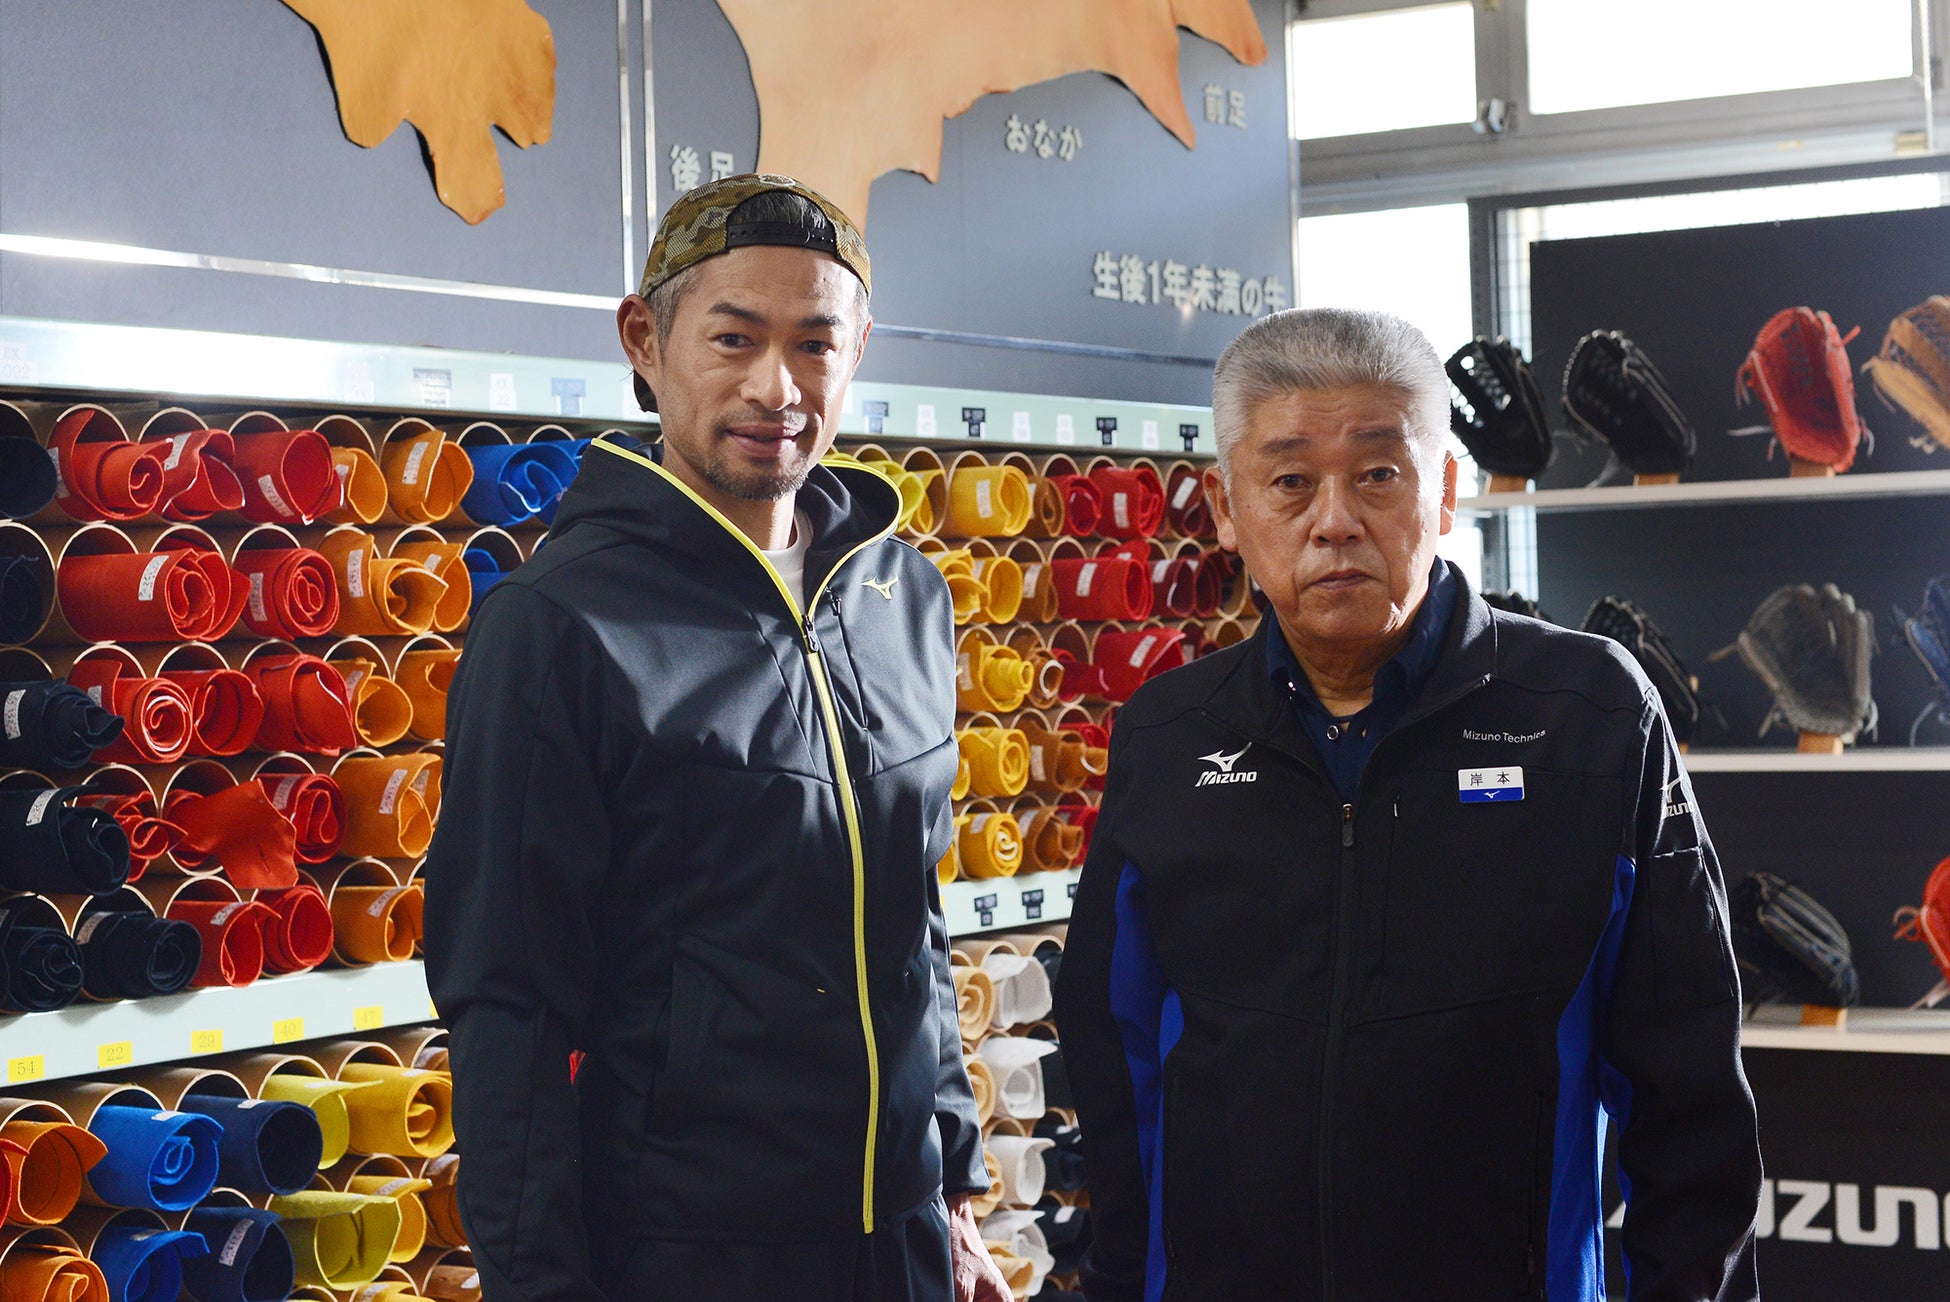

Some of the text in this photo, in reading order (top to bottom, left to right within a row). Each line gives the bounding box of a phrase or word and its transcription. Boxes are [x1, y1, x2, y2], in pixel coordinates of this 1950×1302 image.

[1203, 83, 1247, 129] 前足
[1005, 113, 1083, 161] おなか
[1463, 729, 1501, 741] Mizuno
[1194, 770, 1258, 788] MIZUNO
[1470, 771, 1510, 787] 岸本
[199, 1034, 216, 1049] 29
[106, 1046, 124, 1062] 22
[17, 1060, 34, 1075] 54
